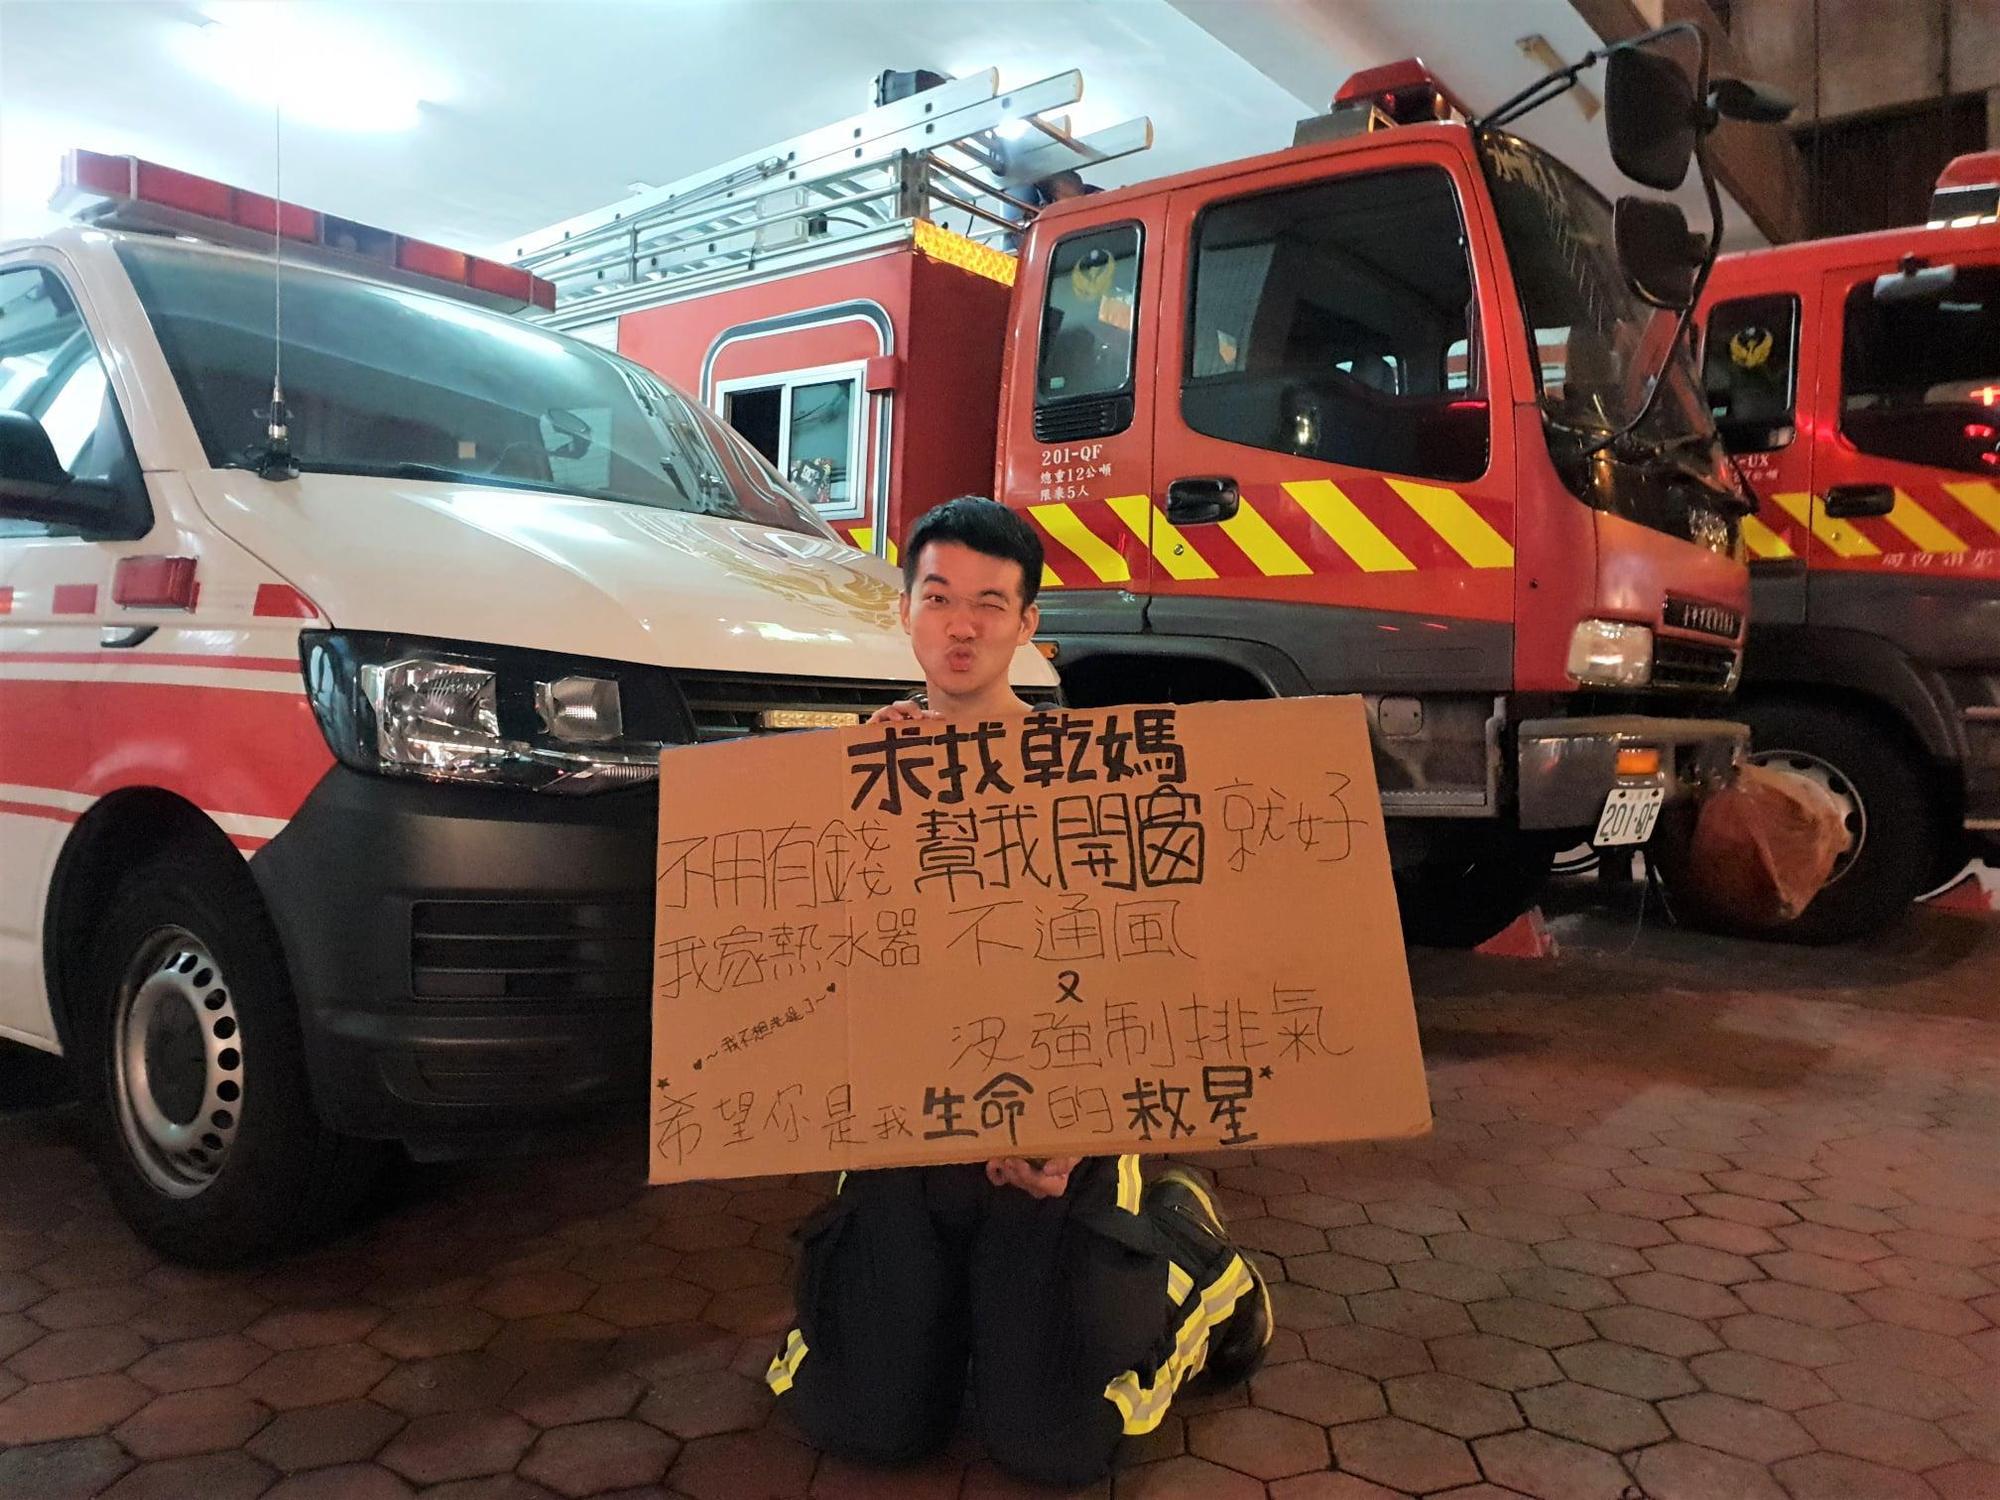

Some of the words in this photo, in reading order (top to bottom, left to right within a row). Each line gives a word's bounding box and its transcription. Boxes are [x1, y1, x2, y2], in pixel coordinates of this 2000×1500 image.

[1041, 444, 1103, 466] 201-QF
[847, 708, 1187, 815] 求找乾媽
[657, 819, 893, 911] 不用有錢
[1213, 771, 1370, 872] 就好
[658, 907, 921, 999] 我家熱水器
[946, 893, 1197, 967] 不通風
[1055, 969, 1084, 1004] 又
[948, 981, 1354, 1072] 沒強制排氣
[655, 1065, 1258, 1167] 希望你是我生命的救星
